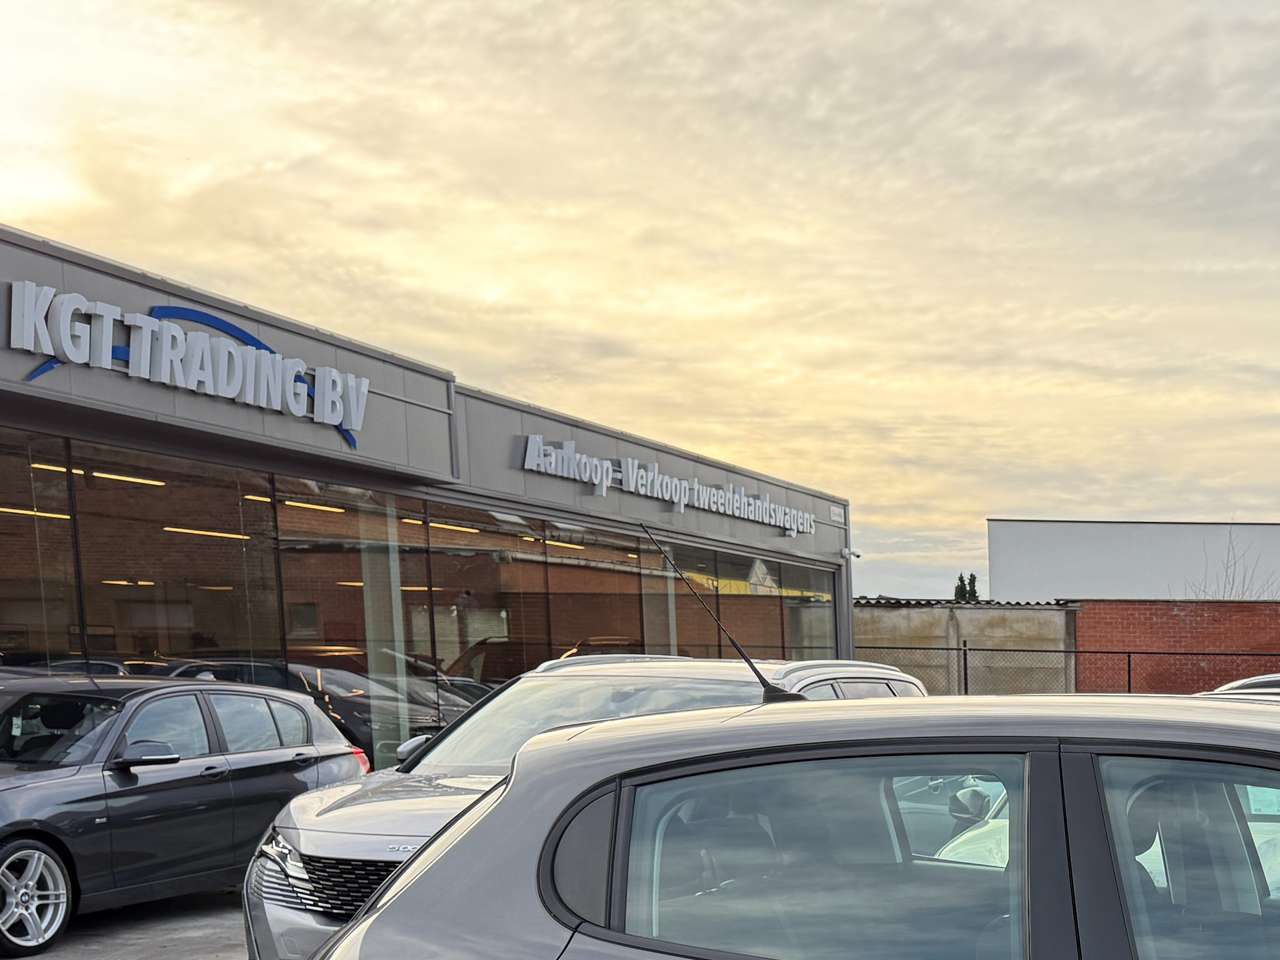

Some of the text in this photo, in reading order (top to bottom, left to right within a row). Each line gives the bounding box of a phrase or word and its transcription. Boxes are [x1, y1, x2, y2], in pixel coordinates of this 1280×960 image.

[10, 280, 370, 432] KGT TRADING BV
[692, 478, 816, 538] tweedehandswagens
